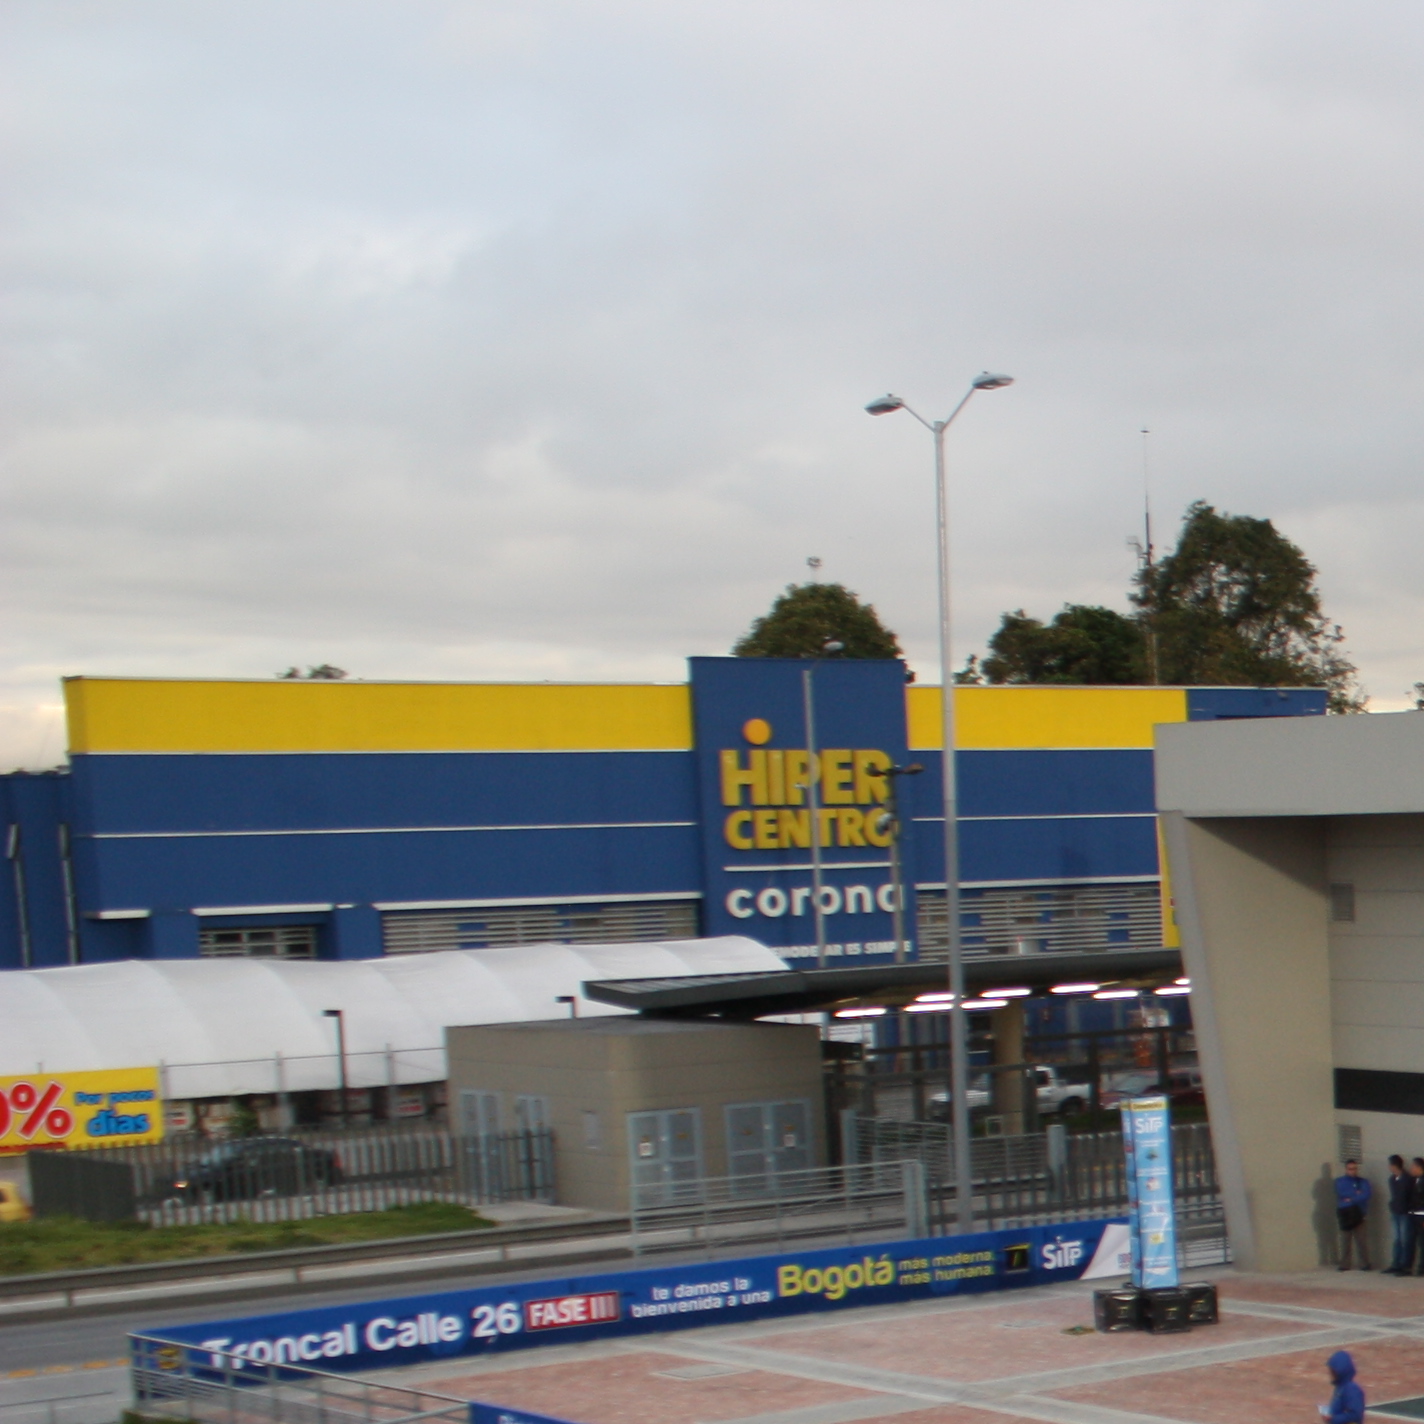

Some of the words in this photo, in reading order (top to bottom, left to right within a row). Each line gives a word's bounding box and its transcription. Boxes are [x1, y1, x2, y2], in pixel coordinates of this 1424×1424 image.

[720, 749, 895, 807] HIPER
[724, 807, 899, 849] CENTRO
[726, 883, 904, 918] corona
[777, 1254, 893, 1300] Bogotá
[899, 1256, 929, 1271] más
[900, 1270, 931, 1286] más
[631, 1294, 723, 1318] bienvenida
[726, 1295, 738, 1307] a
[741, 1291, 771, 1305] una
[652, 1287, 670, 1301] te
[674, 1281, 731, 1298] damos
[734, 1277, 750, 1291] la
[201, 1323, 357, 1370] Troncal
[365, 1312, 463, 1351] Calle
[472, 1301, 523, 1338] 26
[529, 1298, 587, 1328] FASE
